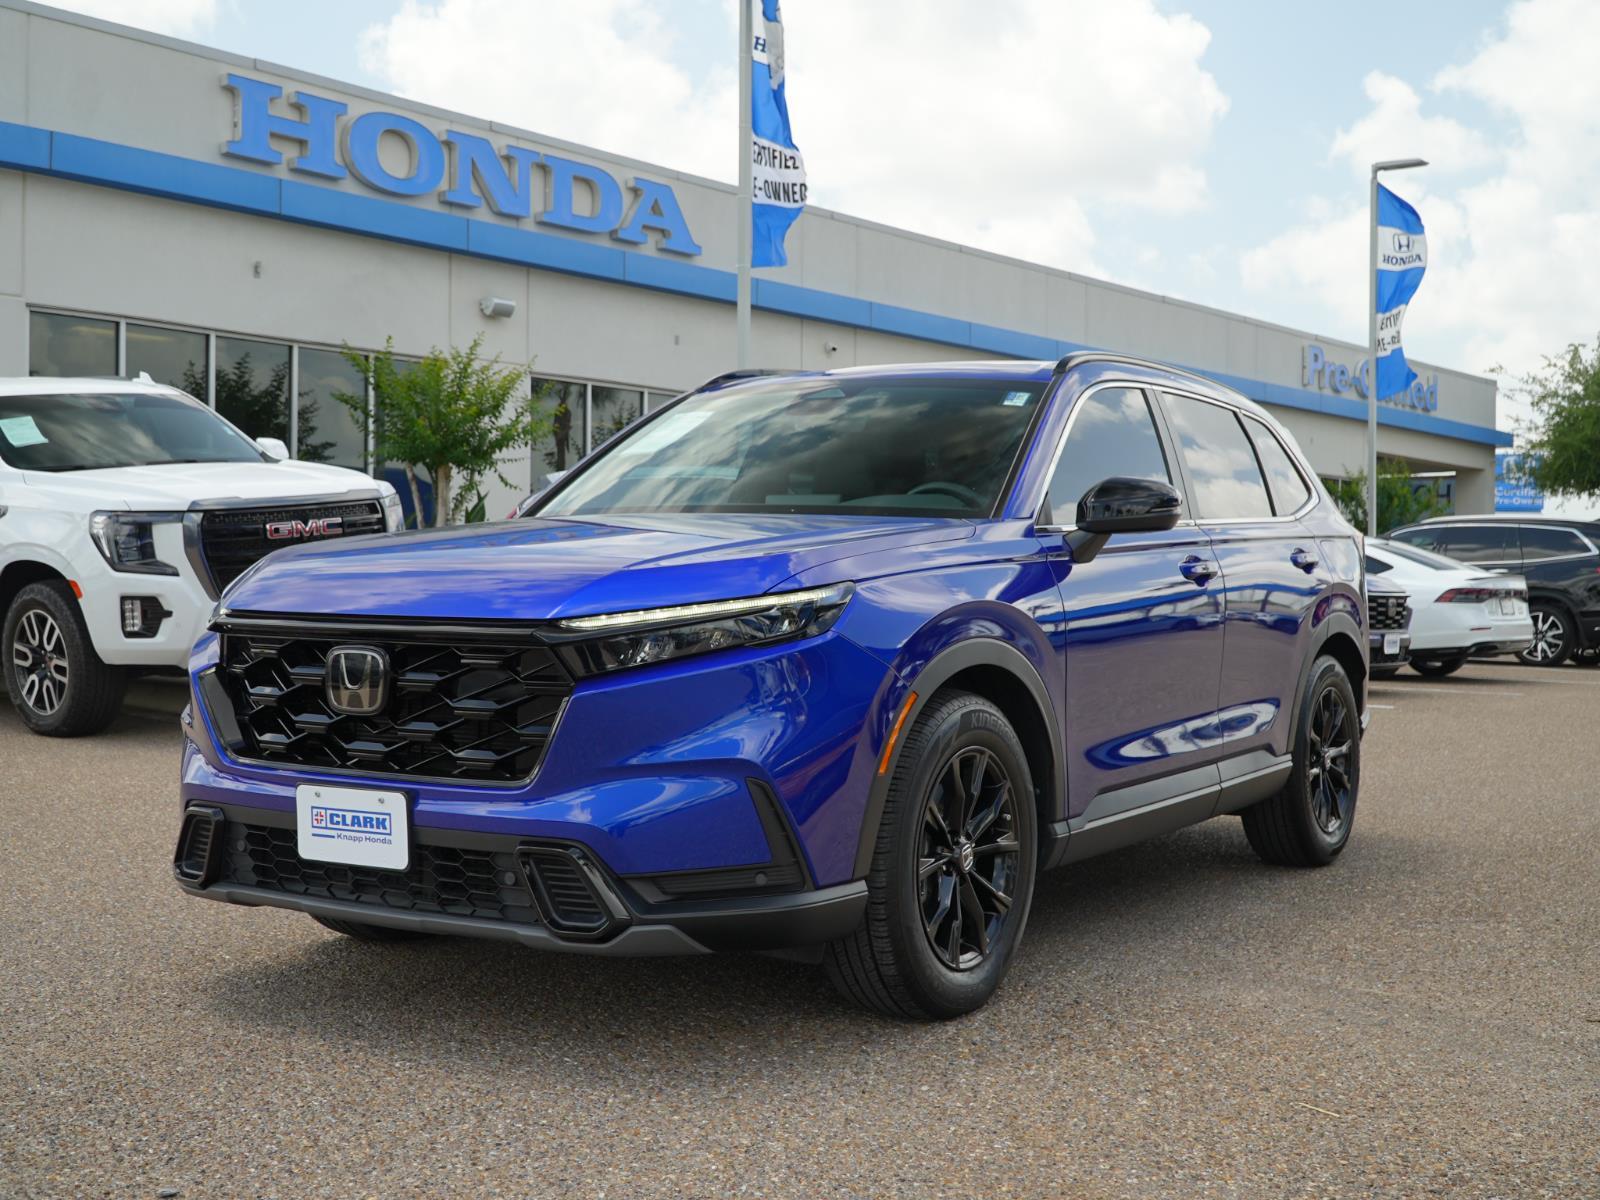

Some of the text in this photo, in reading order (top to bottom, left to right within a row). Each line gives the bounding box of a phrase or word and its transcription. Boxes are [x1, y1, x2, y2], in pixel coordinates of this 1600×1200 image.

[221, 73, 702, 256] HONDA
[753, 176, 808, 203] E-OWNED
[1382, 253, 1422, 266] HONDA
[1304, 343, 1438, 413] Pre-ed
[266, 517, 343, 539] GMC
[329, 812, 388, 830] CLARK
[336, 832, 392, 845] Knapp Honda
